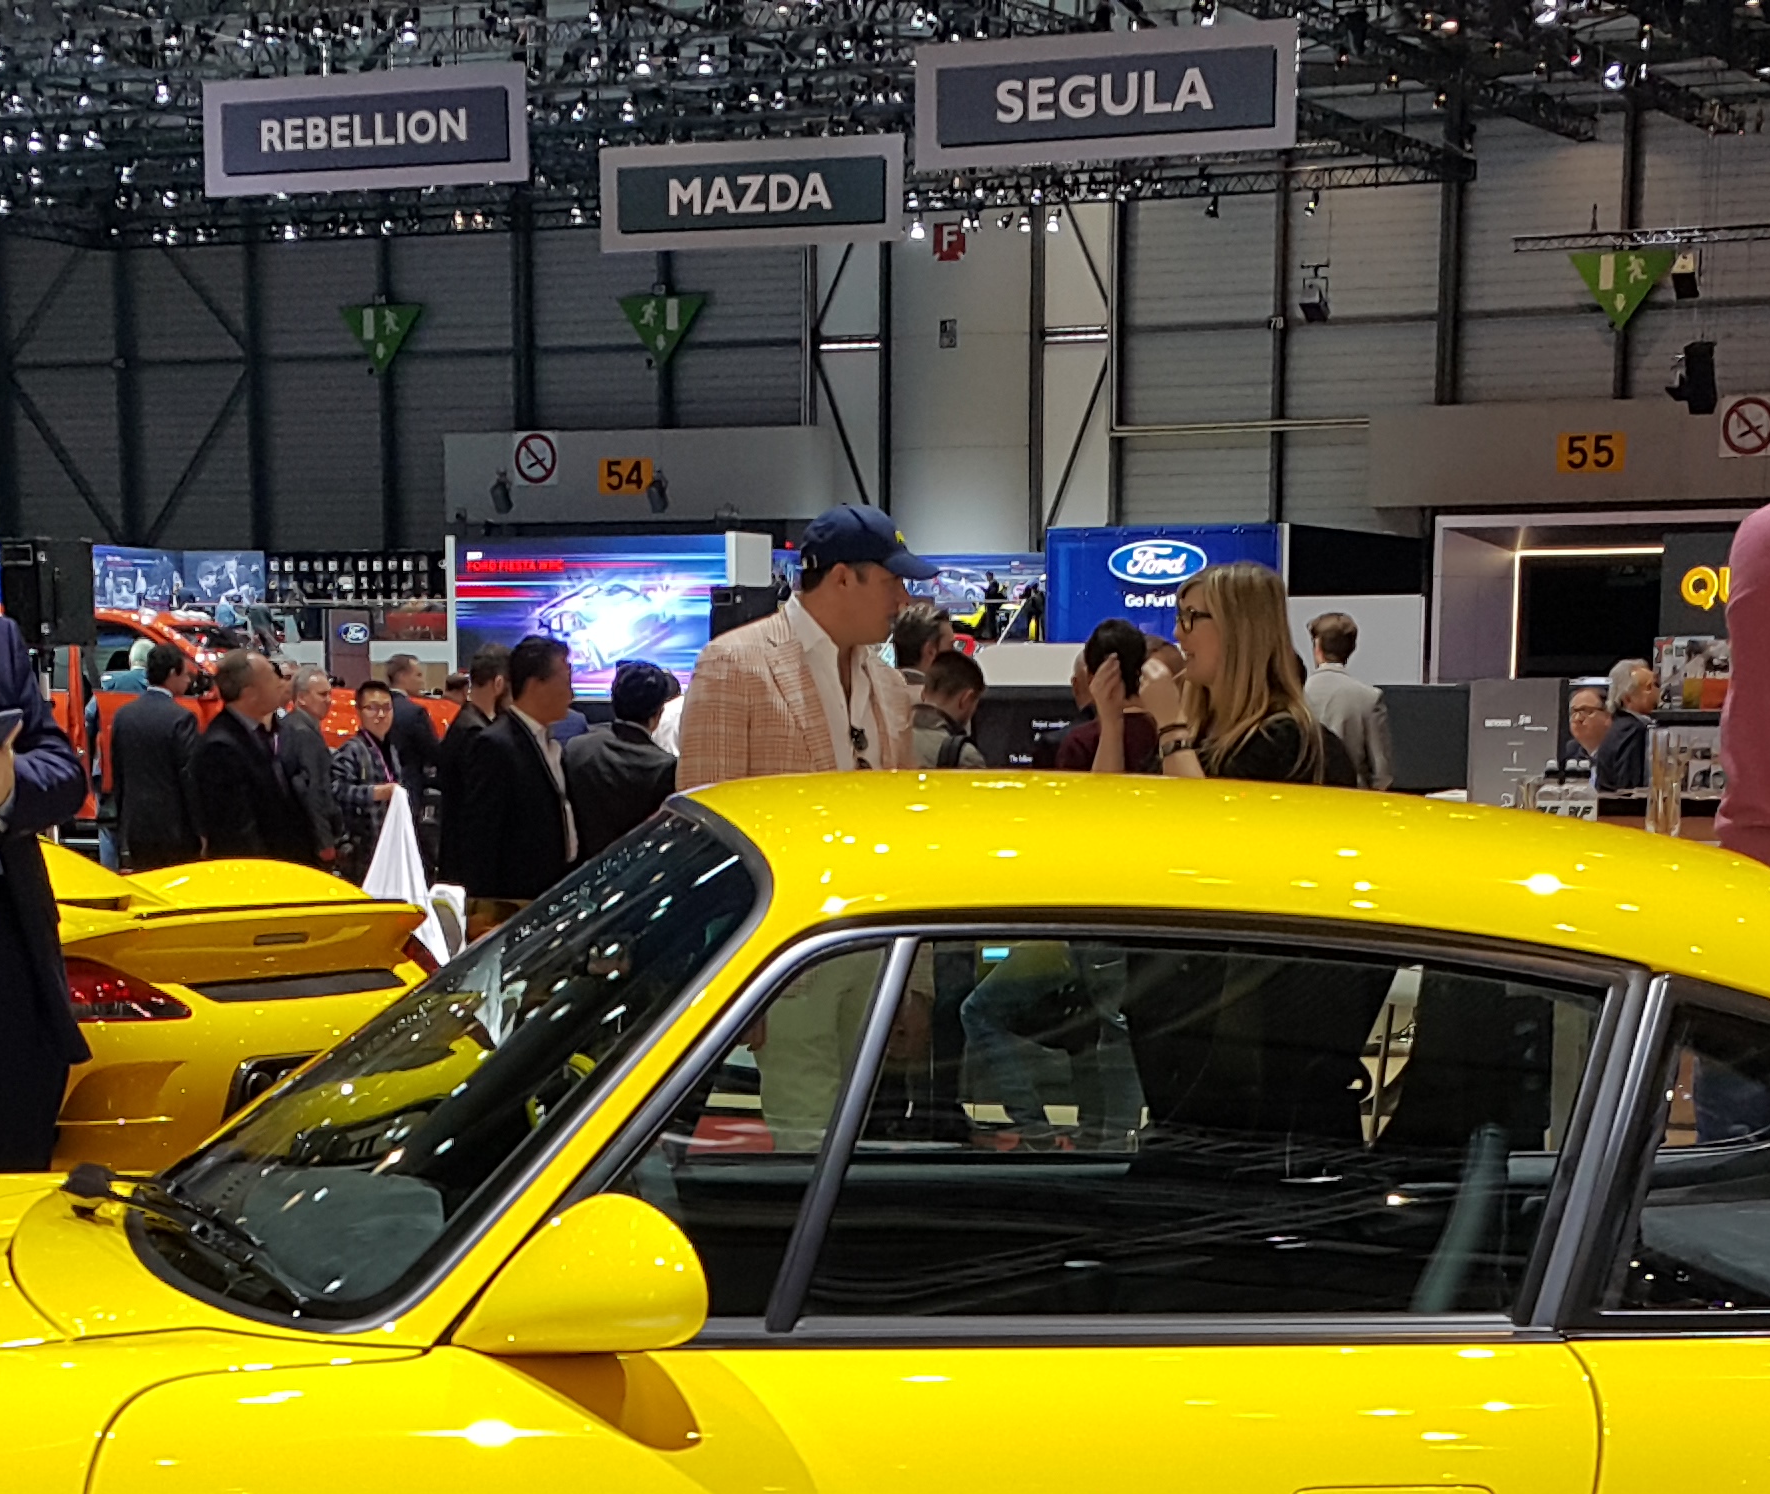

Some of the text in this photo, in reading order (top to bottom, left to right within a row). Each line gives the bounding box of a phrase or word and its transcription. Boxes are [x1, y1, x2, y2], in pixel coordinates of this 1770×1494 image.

[995, 66, 1215, 124] SEGULA
[260, 106, 468, 152] REBELLION
[667, 172, 833, 216] MAZDA
[1567, 434, 1614, 469] 55
[606, 460, 643, 490] 54
[1126, 546, 1187, 575] Ford
[1145, 593, 1177, 607] Furt
